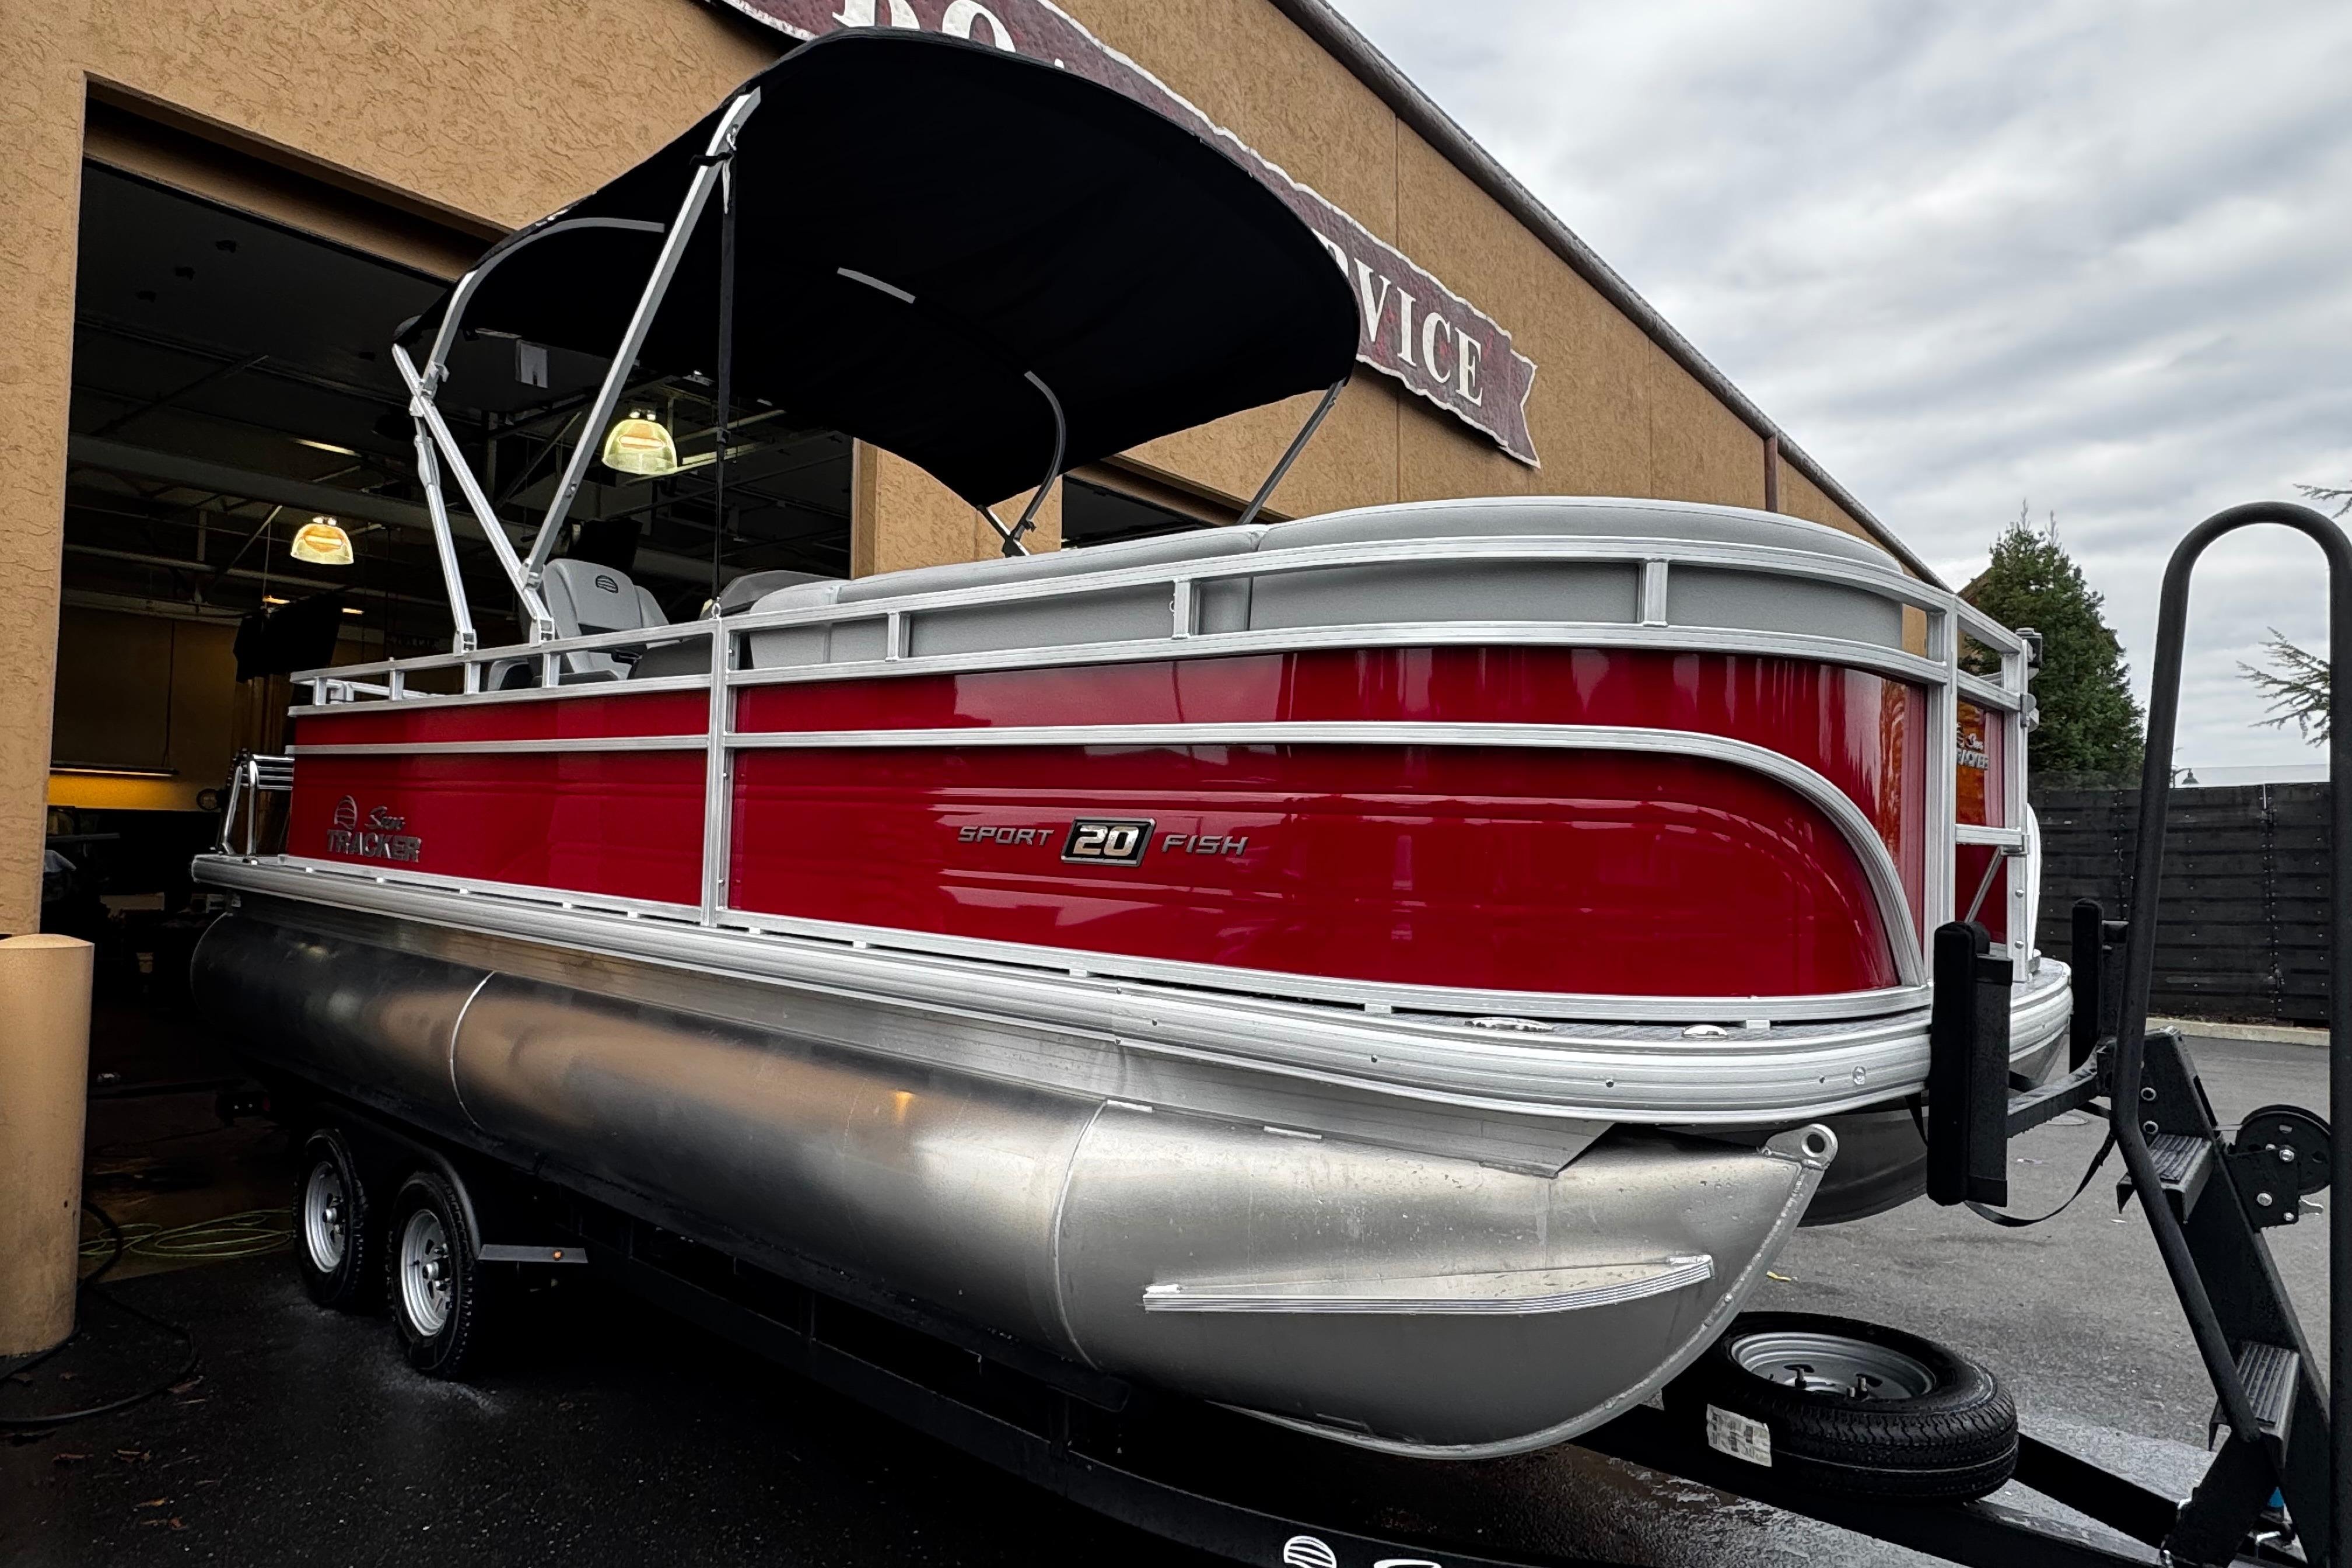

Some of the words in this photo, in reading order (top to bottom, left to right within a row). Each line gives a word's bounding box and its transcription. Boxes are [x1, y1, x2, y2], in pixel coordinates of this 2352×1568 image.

[327, 829, 422, 863] TRACKER
[957, 825, 1054, 846] SPORT
[1072, 825, 1141, 856] 20
[1161, 834, 1249, 856] FISH
